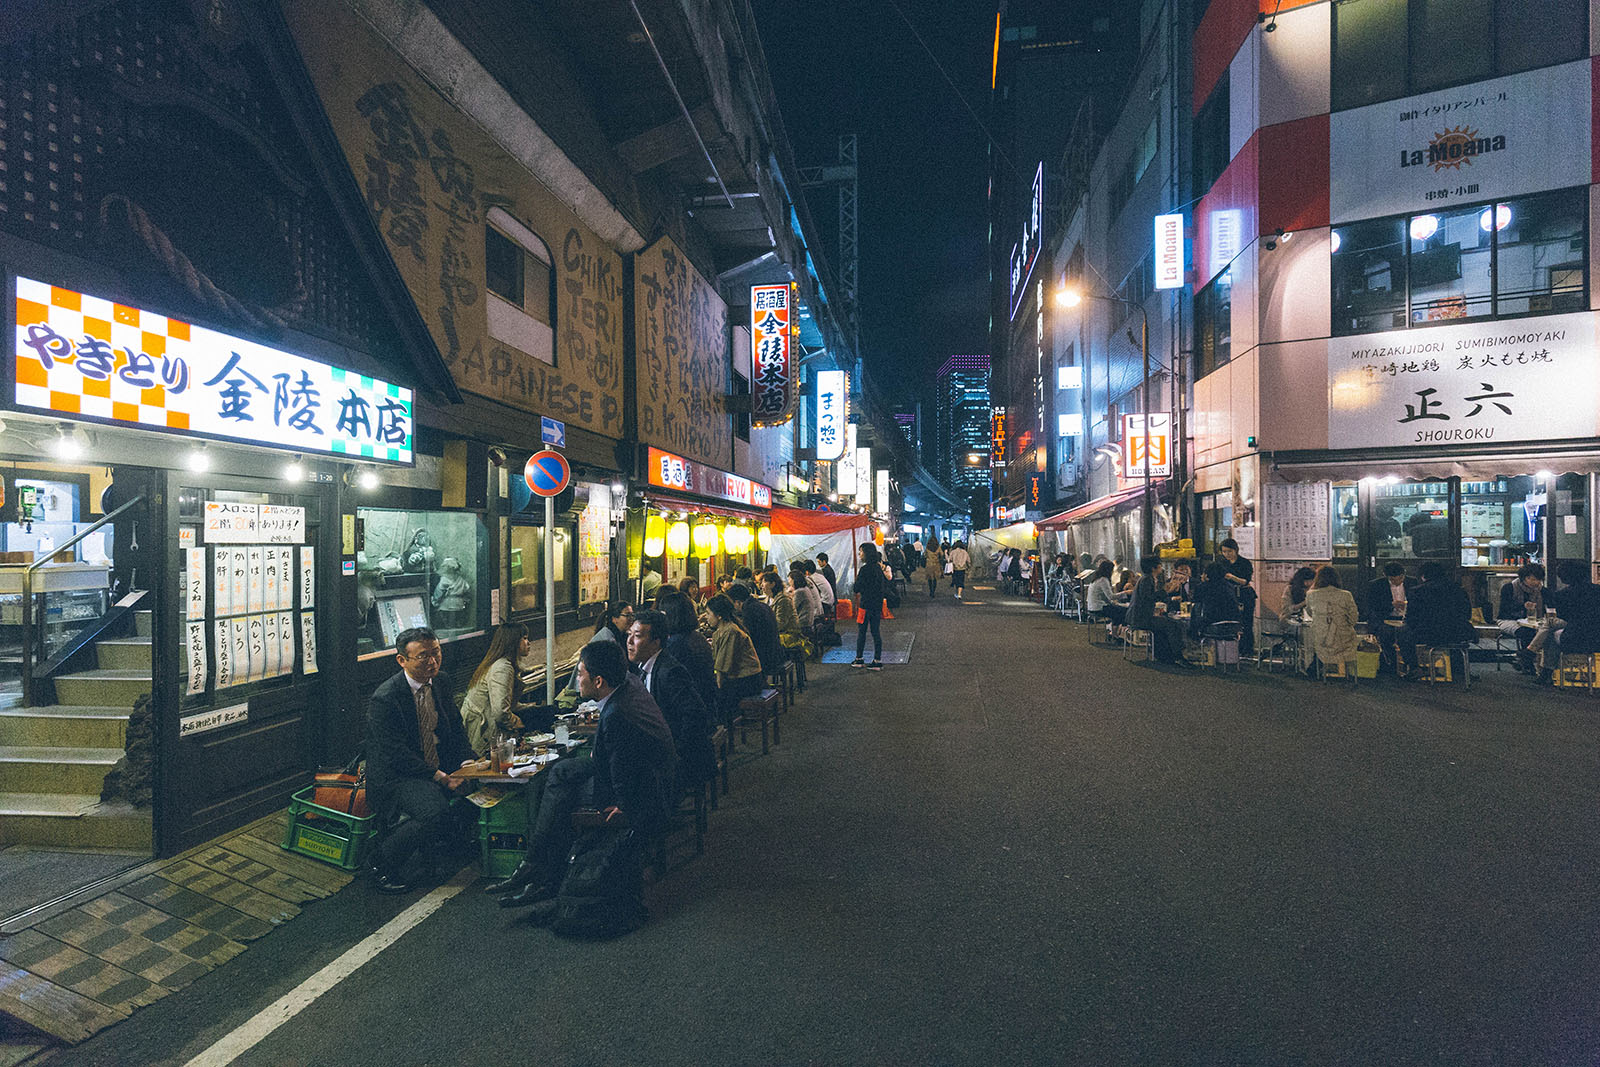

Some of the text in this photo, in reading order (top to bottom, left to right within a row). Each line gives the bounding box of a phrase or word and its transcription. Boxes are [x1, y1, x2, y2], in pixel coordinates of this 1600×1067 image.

[1400, 133, 1506, 168] La Moana
[1163, 221, 1177, 281] La Moana
[565, 277, 617, 345] TERI
[755, 289, 788, 310] 居酒屋
[22, 321, 190, 396] やきとり
[1351, 330, 1567, 360] MIYAZAKIJIDORI SUMIBIMOMOYAKI
[1456, 348, 1553, 371] 炭火もも焼
[754, 311, 788, 414] 金陵本店
[1397, 383, 1515, 424] 正六
[1130, 432, 1166, 467] 肉
[1414, 427, 1495, 443] SHOUROKU
[705, 473, 747, 499] KINRYO
[215, 550, 228, 577] 砂肝
[234, 552, 245, 578] かわ
[250, 620, 262, 655] かしら
[266, 616, 276, 641] はつ
[281, 616, 291, 641] たん
